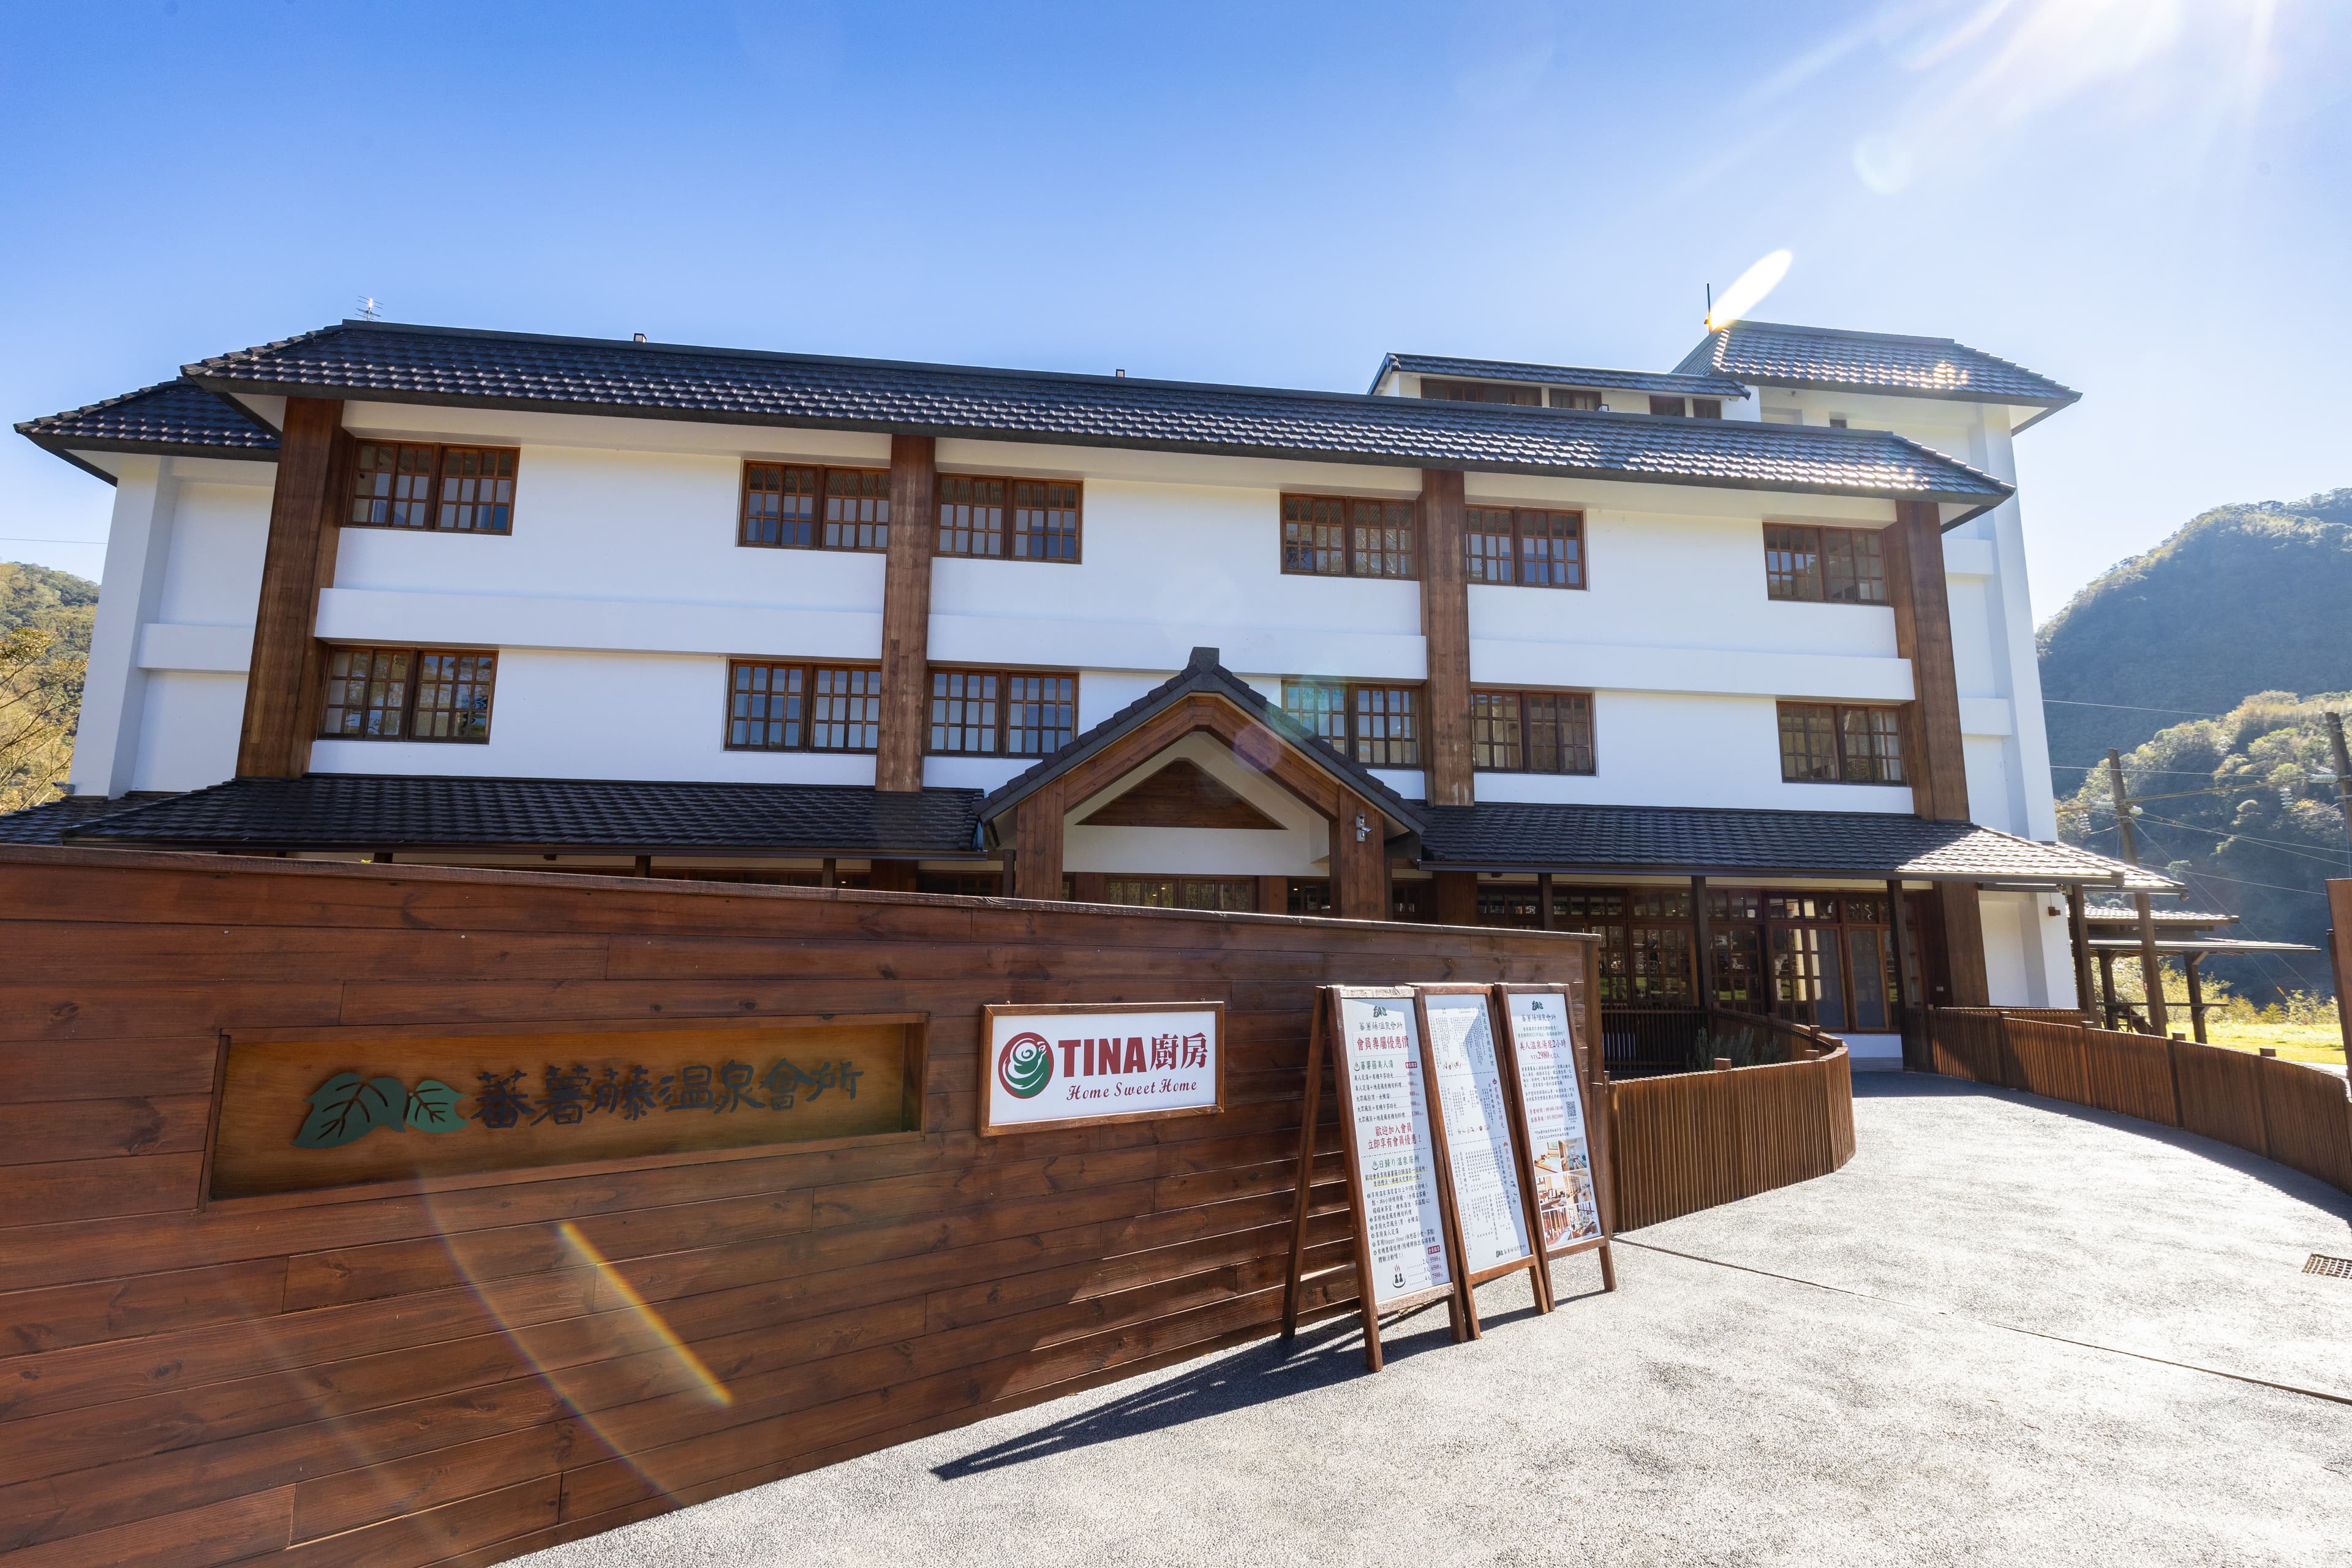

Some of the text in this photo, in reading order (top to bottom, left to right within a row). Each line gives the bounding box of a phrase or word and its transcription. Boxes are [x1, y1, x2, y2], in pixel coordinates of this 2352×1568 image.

[1357, 1035, 1409, 1051] 會員專屬優惠價
[1520, 1038, 1567, 1050] 美人溫泉湯屋2小時
[1066, 1079, 1197, 1101] Home Sweet Home
[1375, 1122, 1412, 1137] 歡迎加入會員
